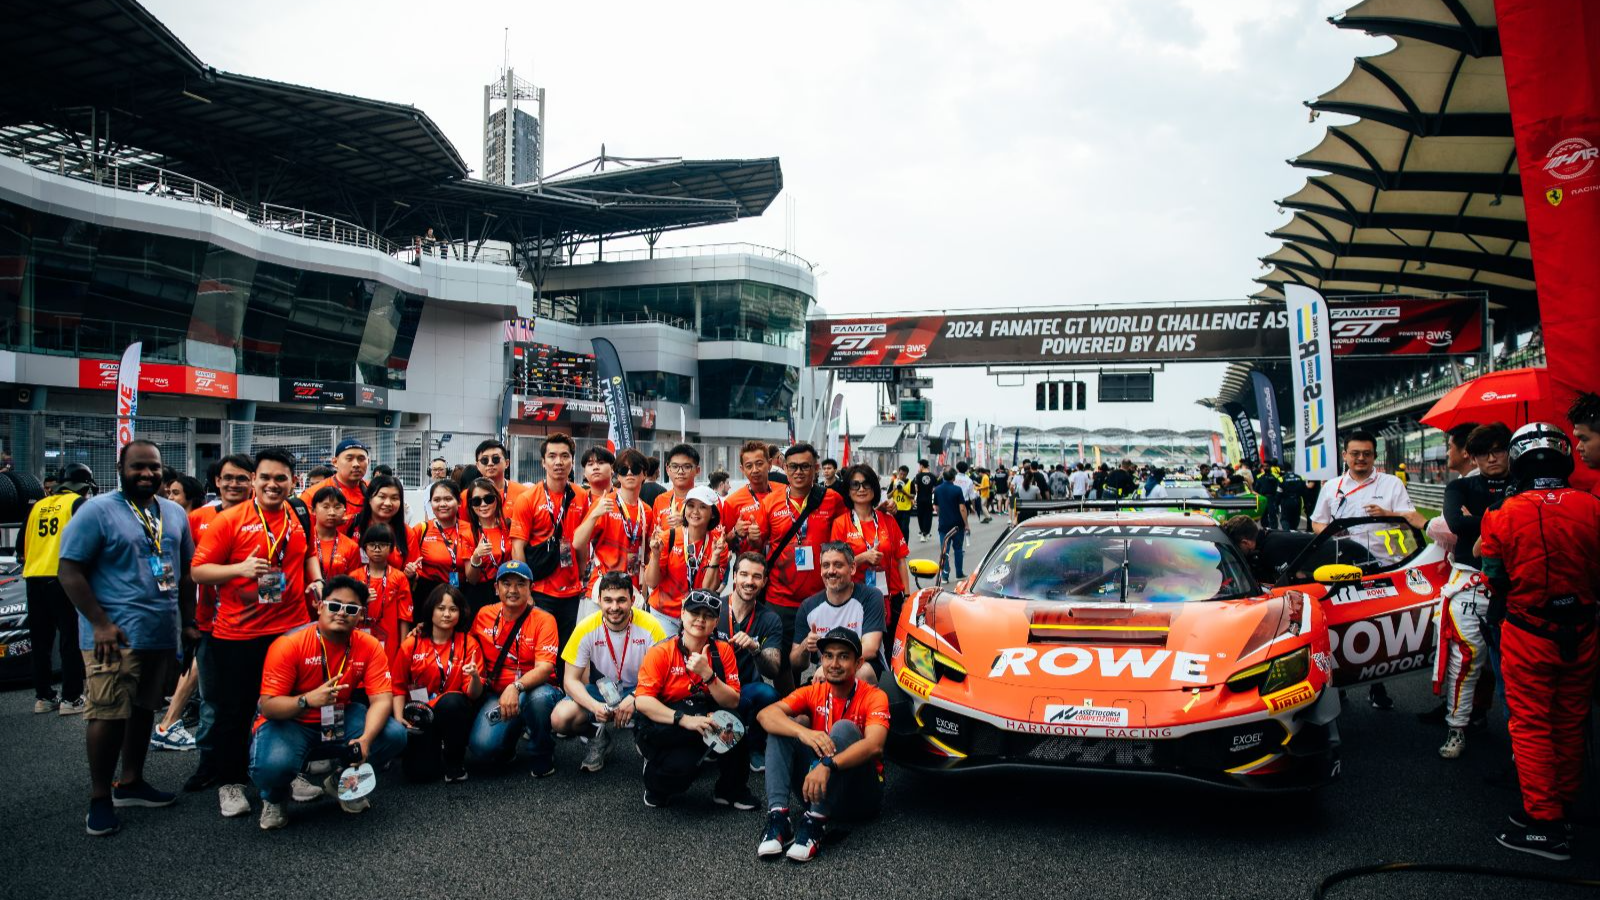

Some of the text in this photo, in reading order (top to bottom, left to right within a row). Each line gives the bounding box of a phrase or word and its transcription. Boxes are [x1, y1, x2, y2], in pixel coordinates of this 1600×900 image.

[1571, 185, 1600, 195] RACIN
[1332, 308, 1398, 317] FANATEC
[833, 325, 885, 333] FANATEC
[945, 311, 1288, 338] 2024 FANATEC GT WORLD CHALLENGE AS
[1041, 334, 1197, 355] POWERED BY AWS
[1426, 331, 1452, 340] aws
[906, 343, 926, 353] aws
[38, 518, 59, 537] 58
[1017, 526, 1203, 540] FANATEC
[1004, 540, 1044, 562] 77
[1375, 529, 1408, 555] 77
[1366, 588, 1387, 597] ROWE
[1461, 601, 1478, 615] 77
[987, 647, 1210, 683] ROWE
[1360, 654, 1425, 680] MOTOR
[900, 672, 929, 696] PIRELLI
[1269, 685, 1312, 711] PIRELLI
[1075, 715, 1121, 723] COMPETIZIONE
[1006, 720, 1172, 738] HARMONY RACING
